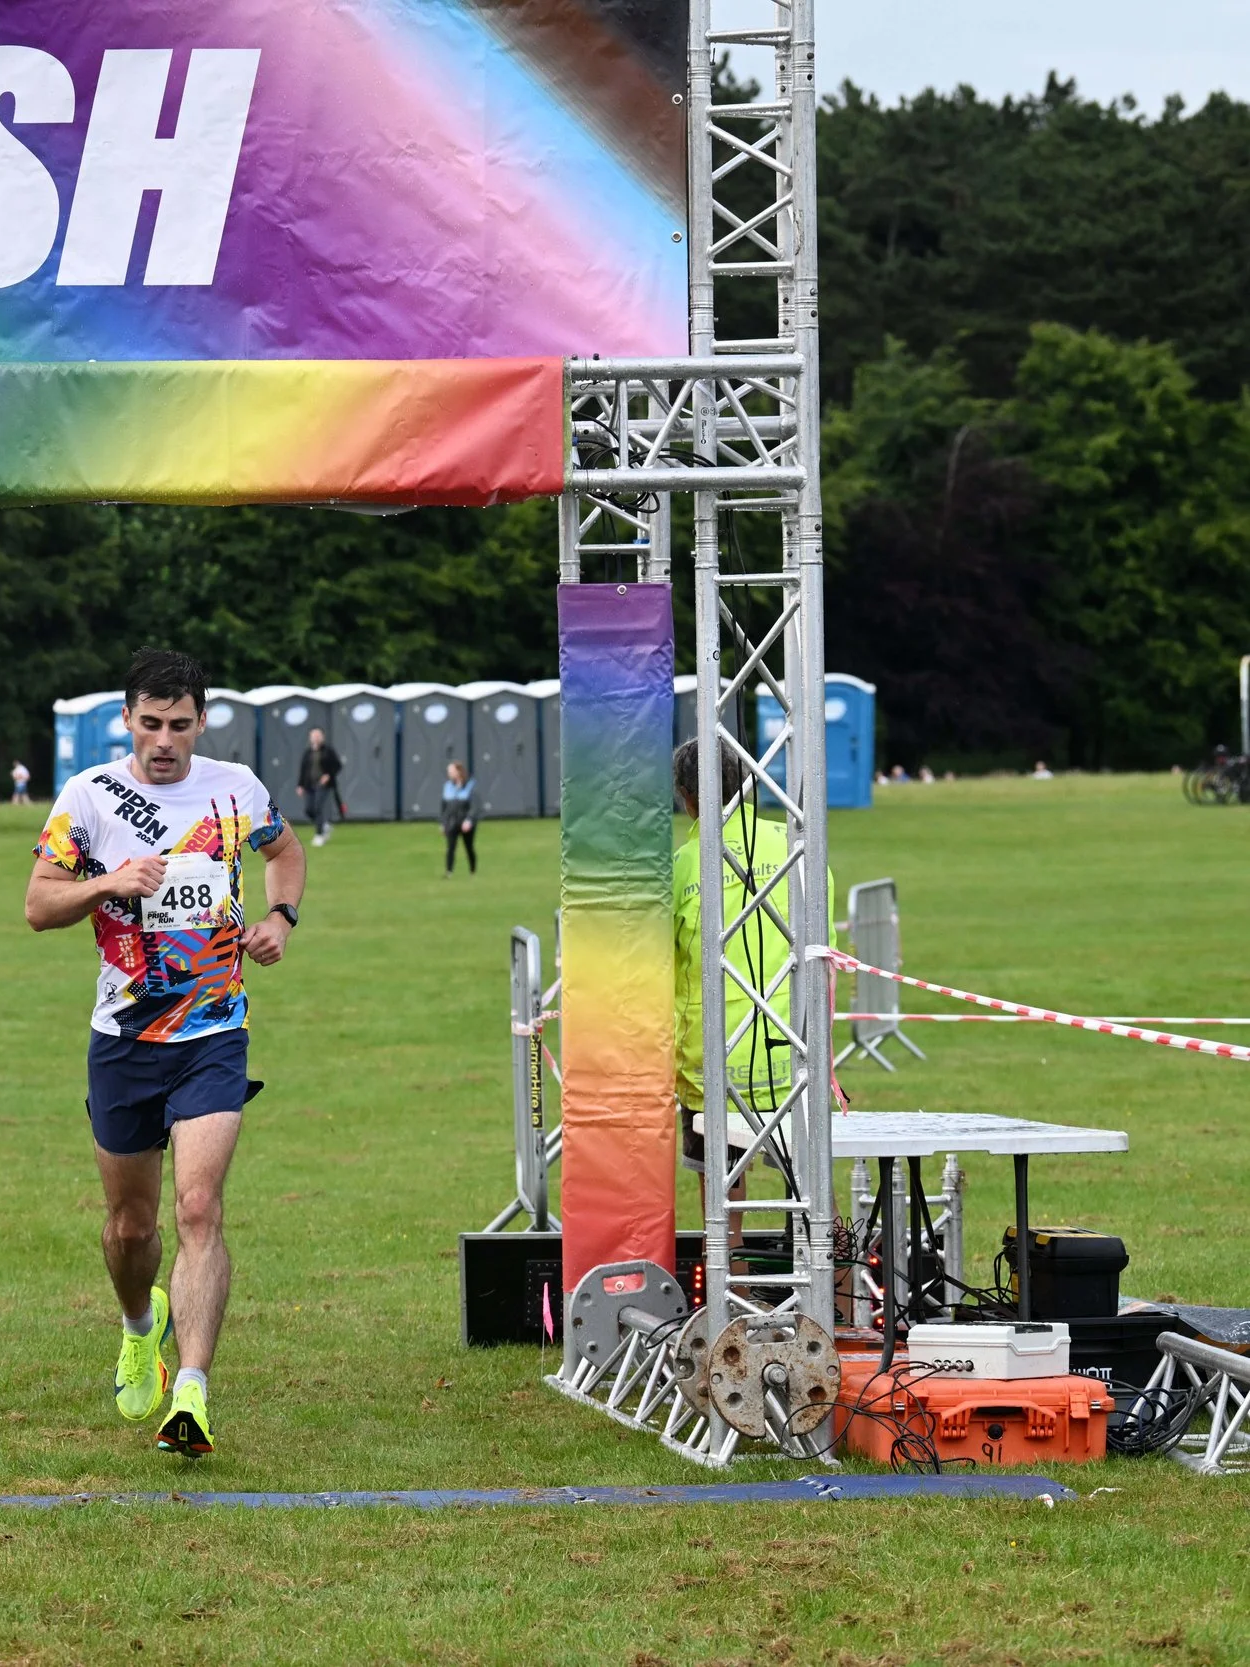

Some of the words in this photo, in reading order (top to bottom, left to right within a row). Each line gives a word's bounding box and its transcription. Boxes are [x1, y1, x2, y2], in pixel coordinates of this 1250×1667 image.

[91, 775, 161, 816] PRIDE
[114, 801, 169, 840] RUN
[135, 831, 156, 846] 2024
[161, 884, 213, 910] 488
[100, 900, 136, 927] 024
[147, 912, 169, 920] PRIDE
[140, 931, 167, 993] DUBLIN
